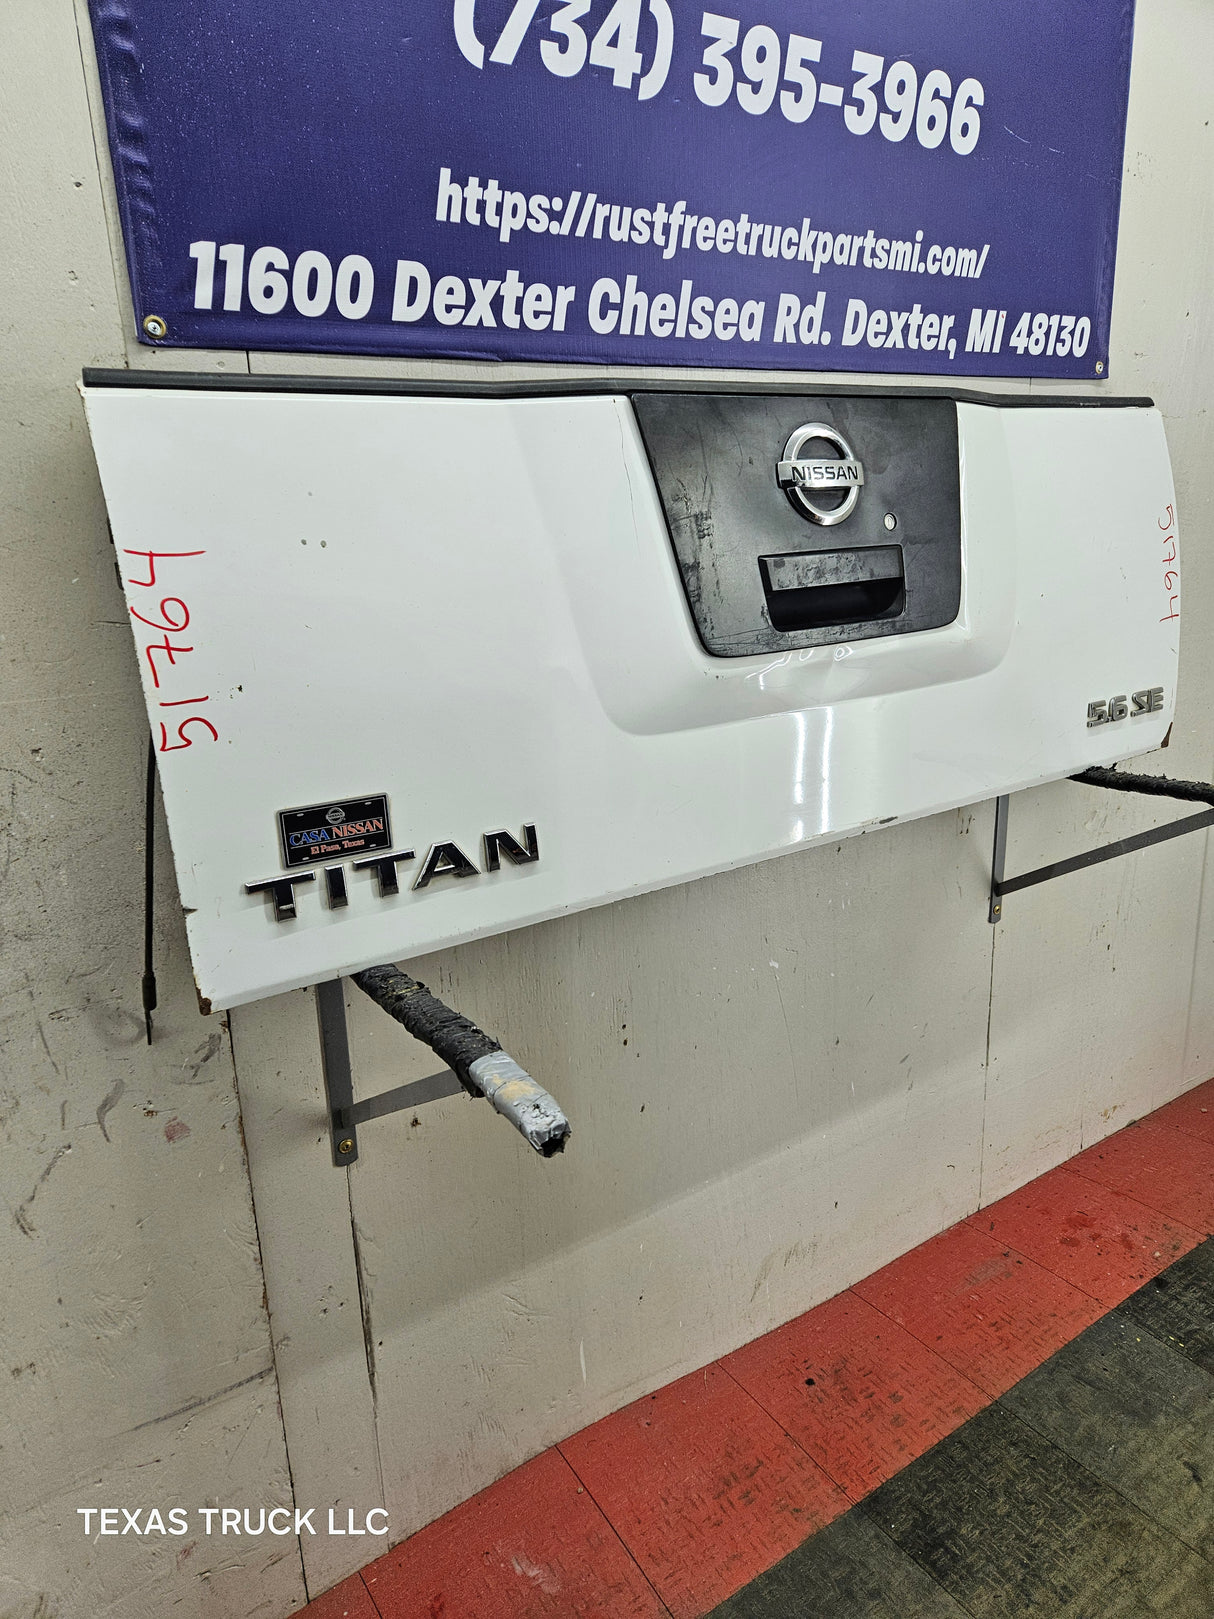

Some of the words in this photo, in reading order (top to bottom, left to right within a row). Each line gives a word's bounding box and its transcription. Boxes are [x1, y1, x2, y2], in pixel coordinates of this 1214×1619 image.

[693, 12, 985, 156] 395-3966
[435, 167, 990, 280] https://rustfreetruckpartsmi.com/
[188, 240, 375, 320] 11600
[391, 259, 576, 332] Dexter
[587, 274, 766, 342] Chelsea
[773, 291, 832, 346] Rd.
[841, 298, 957, 360] Dexter,
[965, 308, 1007, 354] MI
[1009, 312, 1092, 358] 48130
[791, 466, 859, 481] NISSAN
[1158, 503, 1179, 622] 51764
[123, 548, 219, 752] 51764
[245, 822, 540, 922] TITAN
[289, 829, 330, 846] CASA
[332, 818, 383, 839] NISSAN
[310, 846, 320, 855] El
[341, 839, 365, 848] Texas
